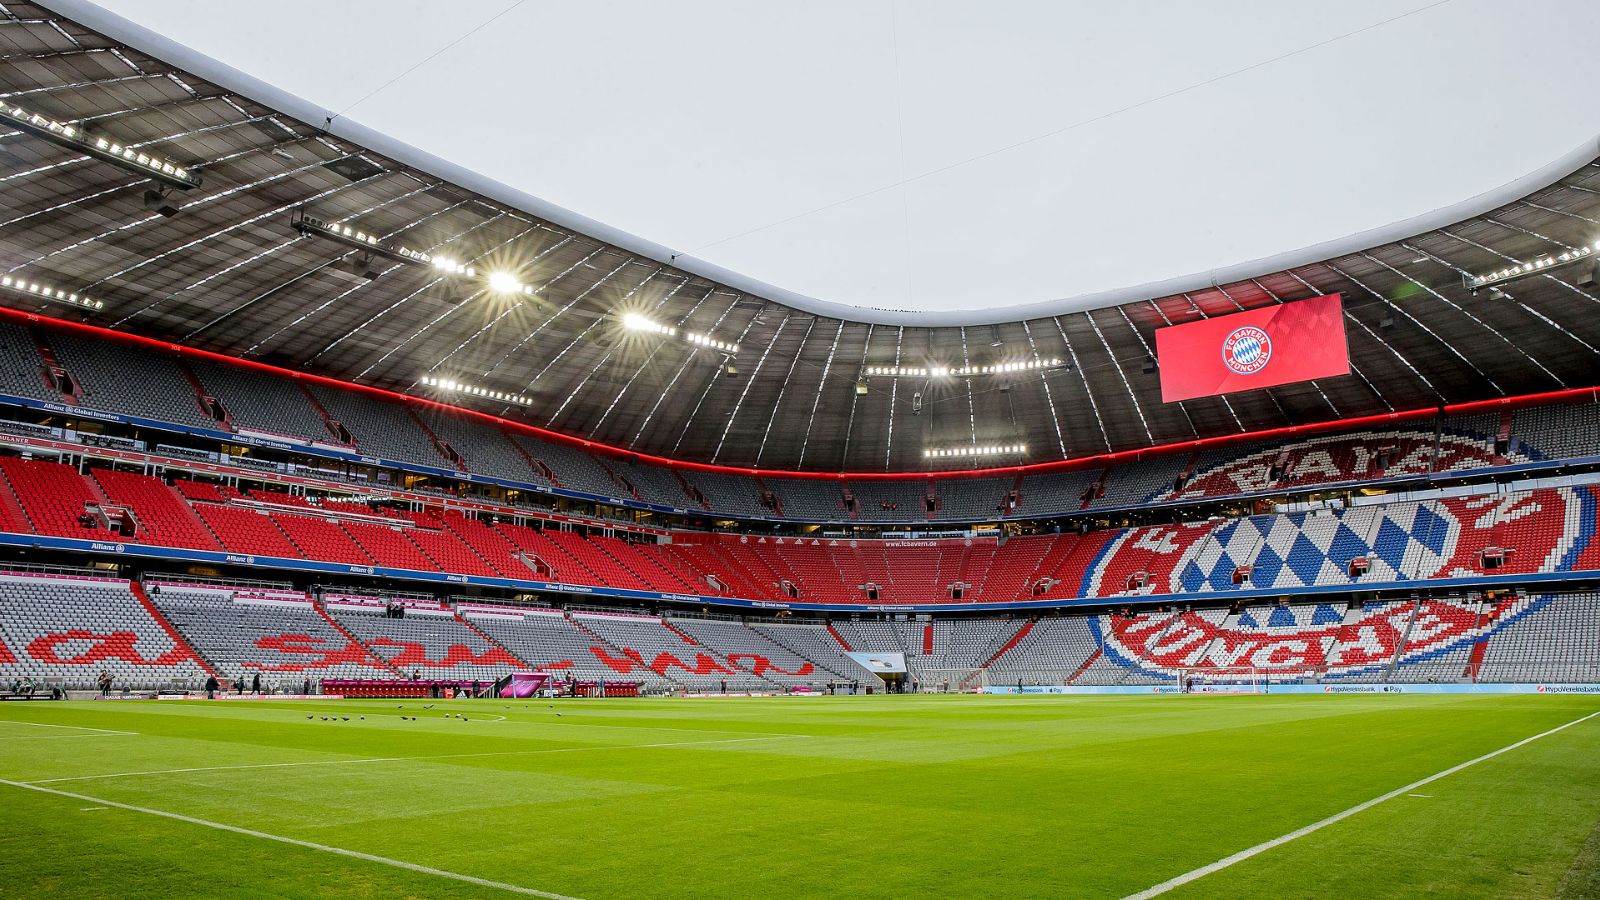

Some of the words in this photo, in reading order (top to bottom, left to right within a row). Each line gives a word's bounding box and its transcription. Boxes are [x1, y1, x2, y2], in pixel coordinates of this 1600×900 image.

[1226, 339, 1235, 351] FC
[1234, 329, 1267, 344] BAYERN
[43, 403, 64, 412] Allianz
[74, 408, 93, 416] Global
[93, 412, 120, 421] Investors
[231, 434, 248, 443] Allianz
[91, 543, 115, 551] Allianz
